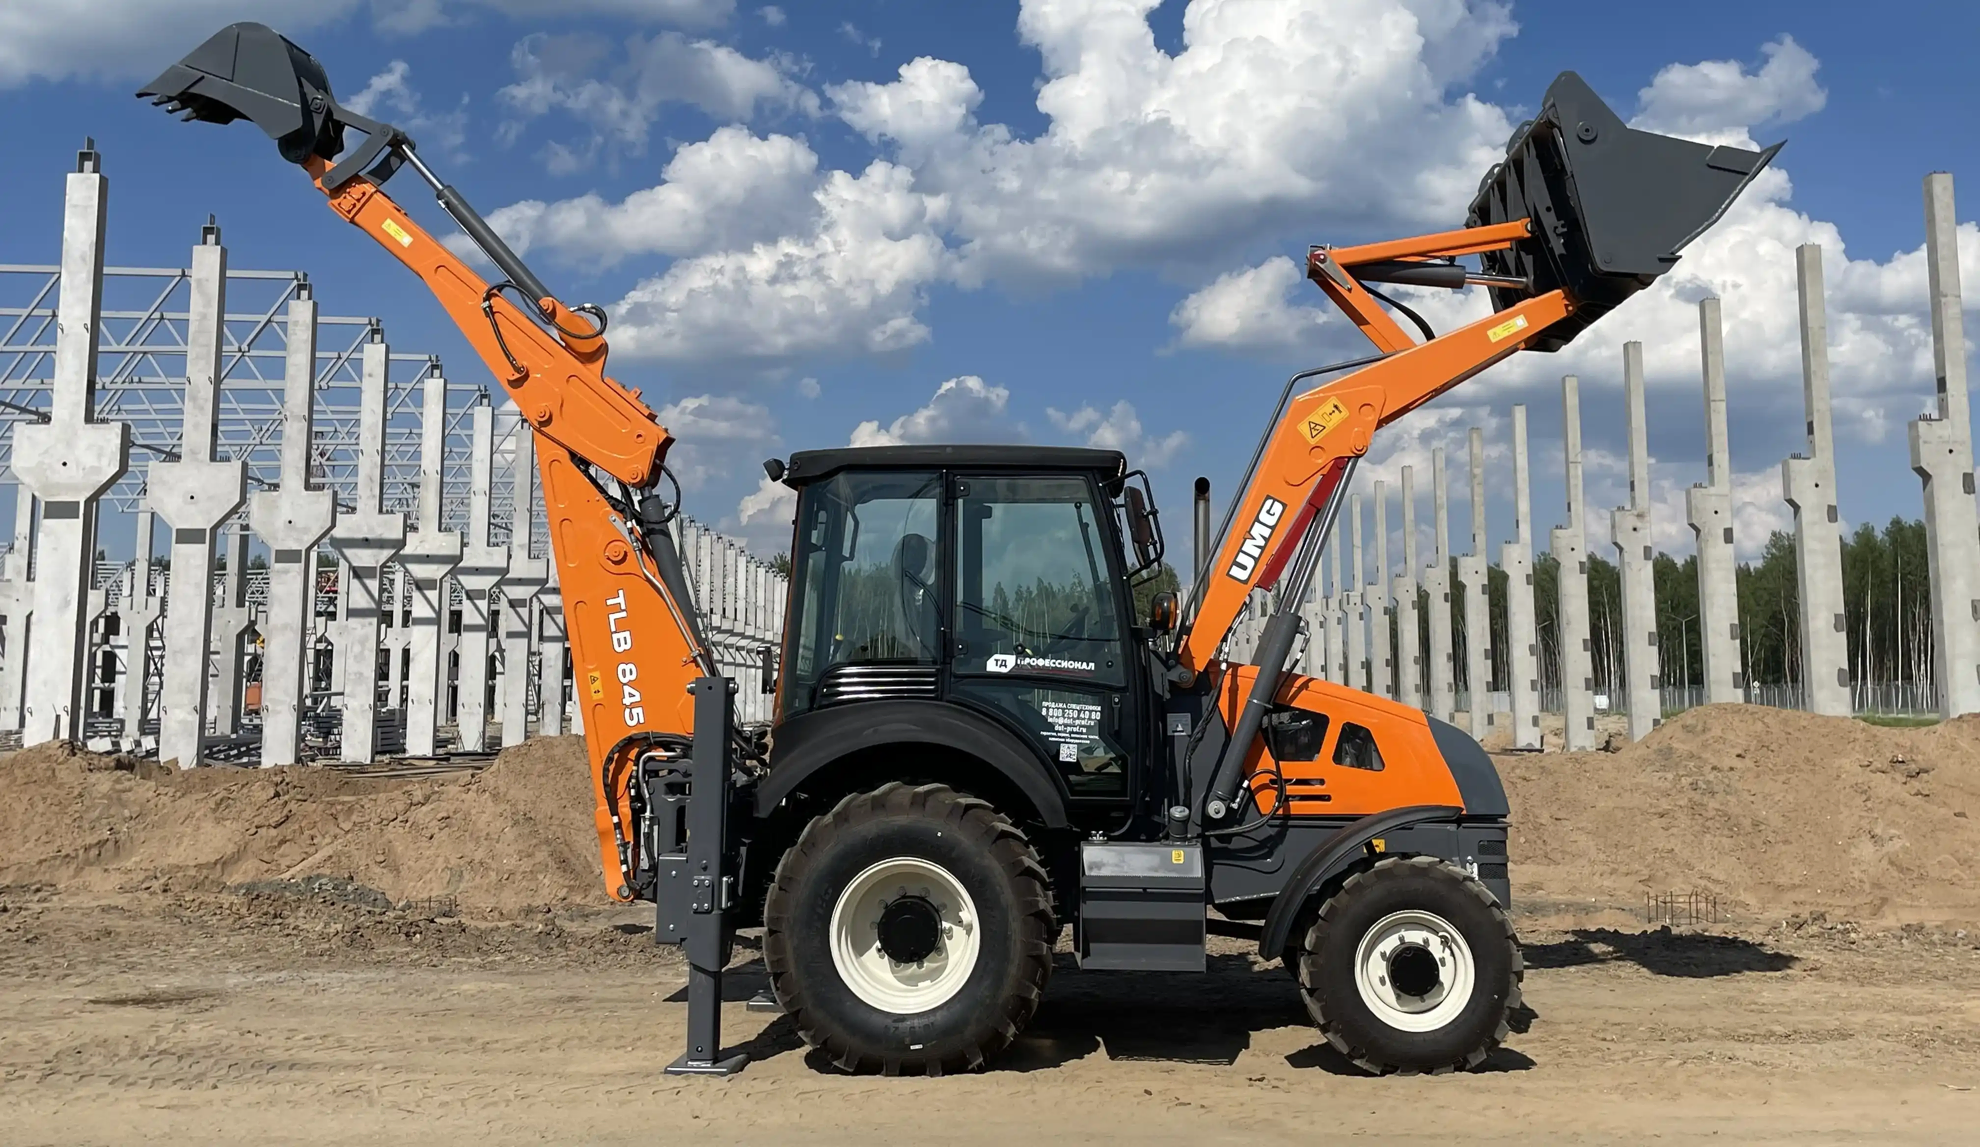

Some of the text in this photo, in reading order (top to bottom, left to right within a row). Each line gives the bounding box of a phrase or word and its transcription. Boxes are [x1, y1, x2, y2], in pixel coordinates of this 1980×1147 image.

[1228, 498, 1283, 581] UMG
[605, 588, 645, 727] TLB 845
[994, 657, 1095, 670] ТД ПРОФЕССИОНАЛ
[1041, 707, 1101, 720] 8 800 250 40 80
